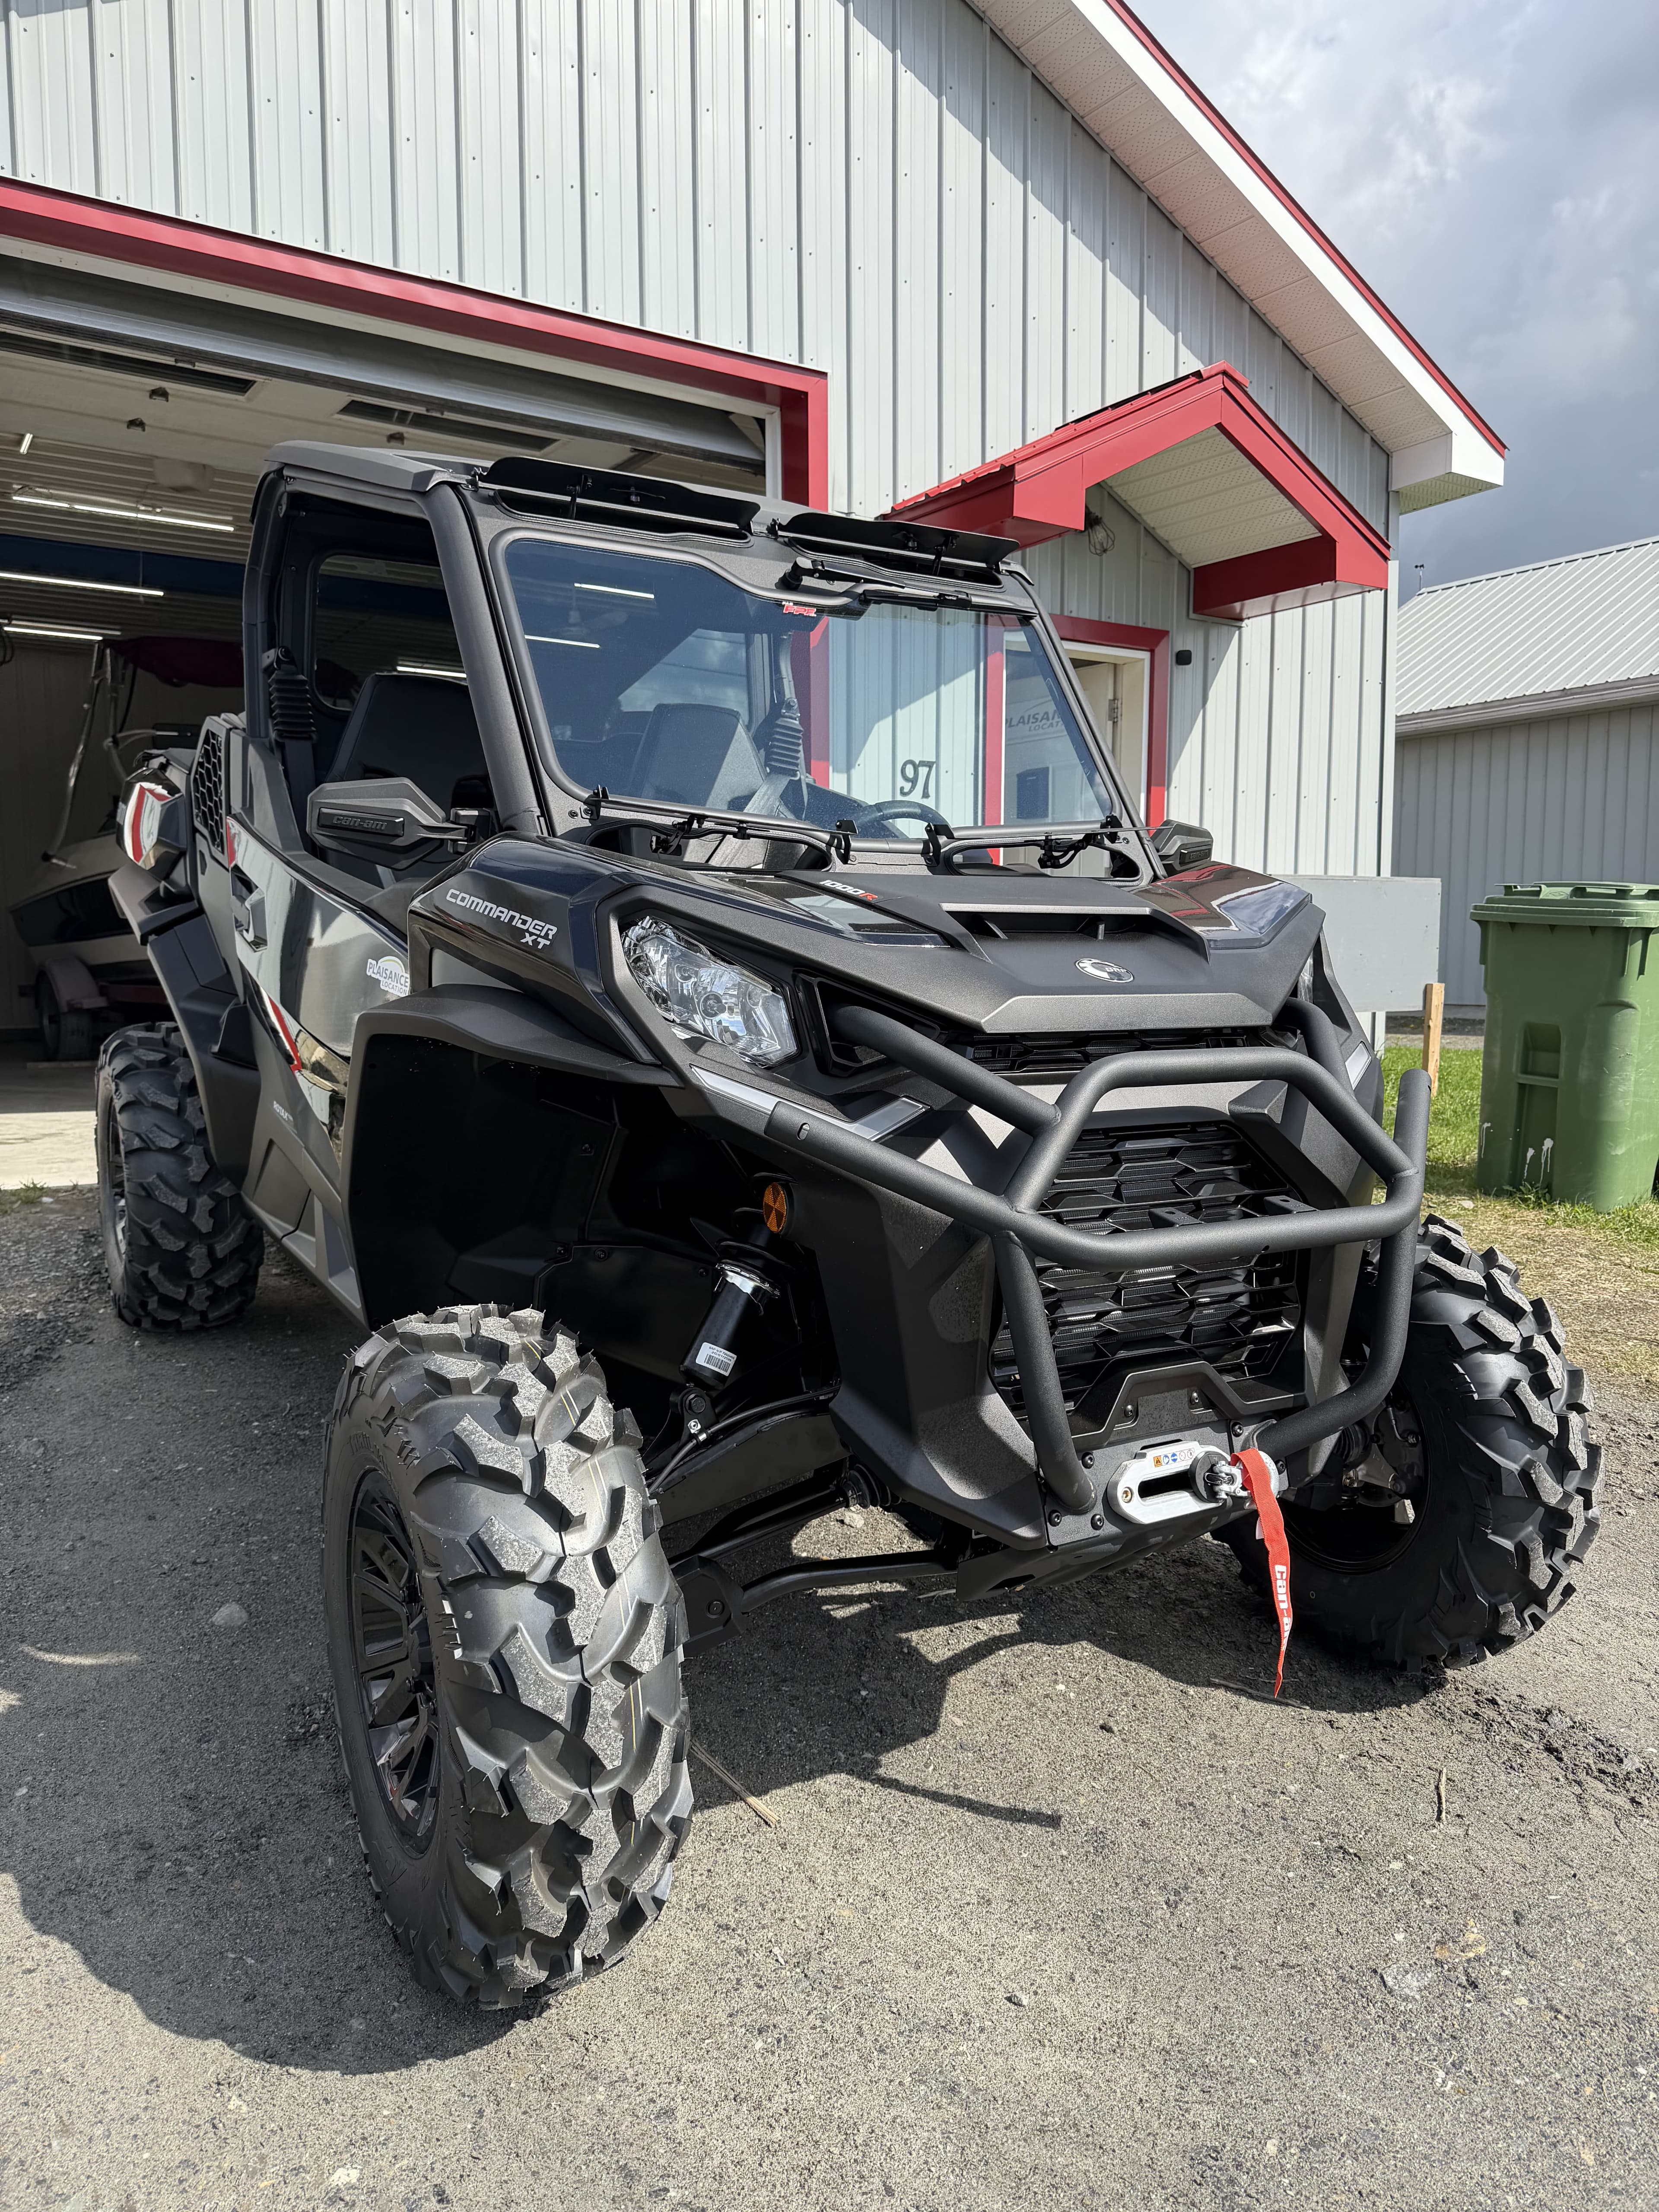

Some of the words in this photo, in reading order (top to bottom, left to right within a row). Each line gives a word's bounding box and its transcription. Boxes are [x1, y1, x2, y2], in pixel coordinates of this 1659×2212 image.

[899, 760, 936, 799] 97
[819, 880, 878, 901] 1000R
[446, 889, 557, 940] COMMANDER
[520, 932, 550, 949] XT
[368, 962, 409, 988] PLAISANCE
[381, 980, 407, 995] LOCATION
[273, 1100, 288, 1121] ROTAX
